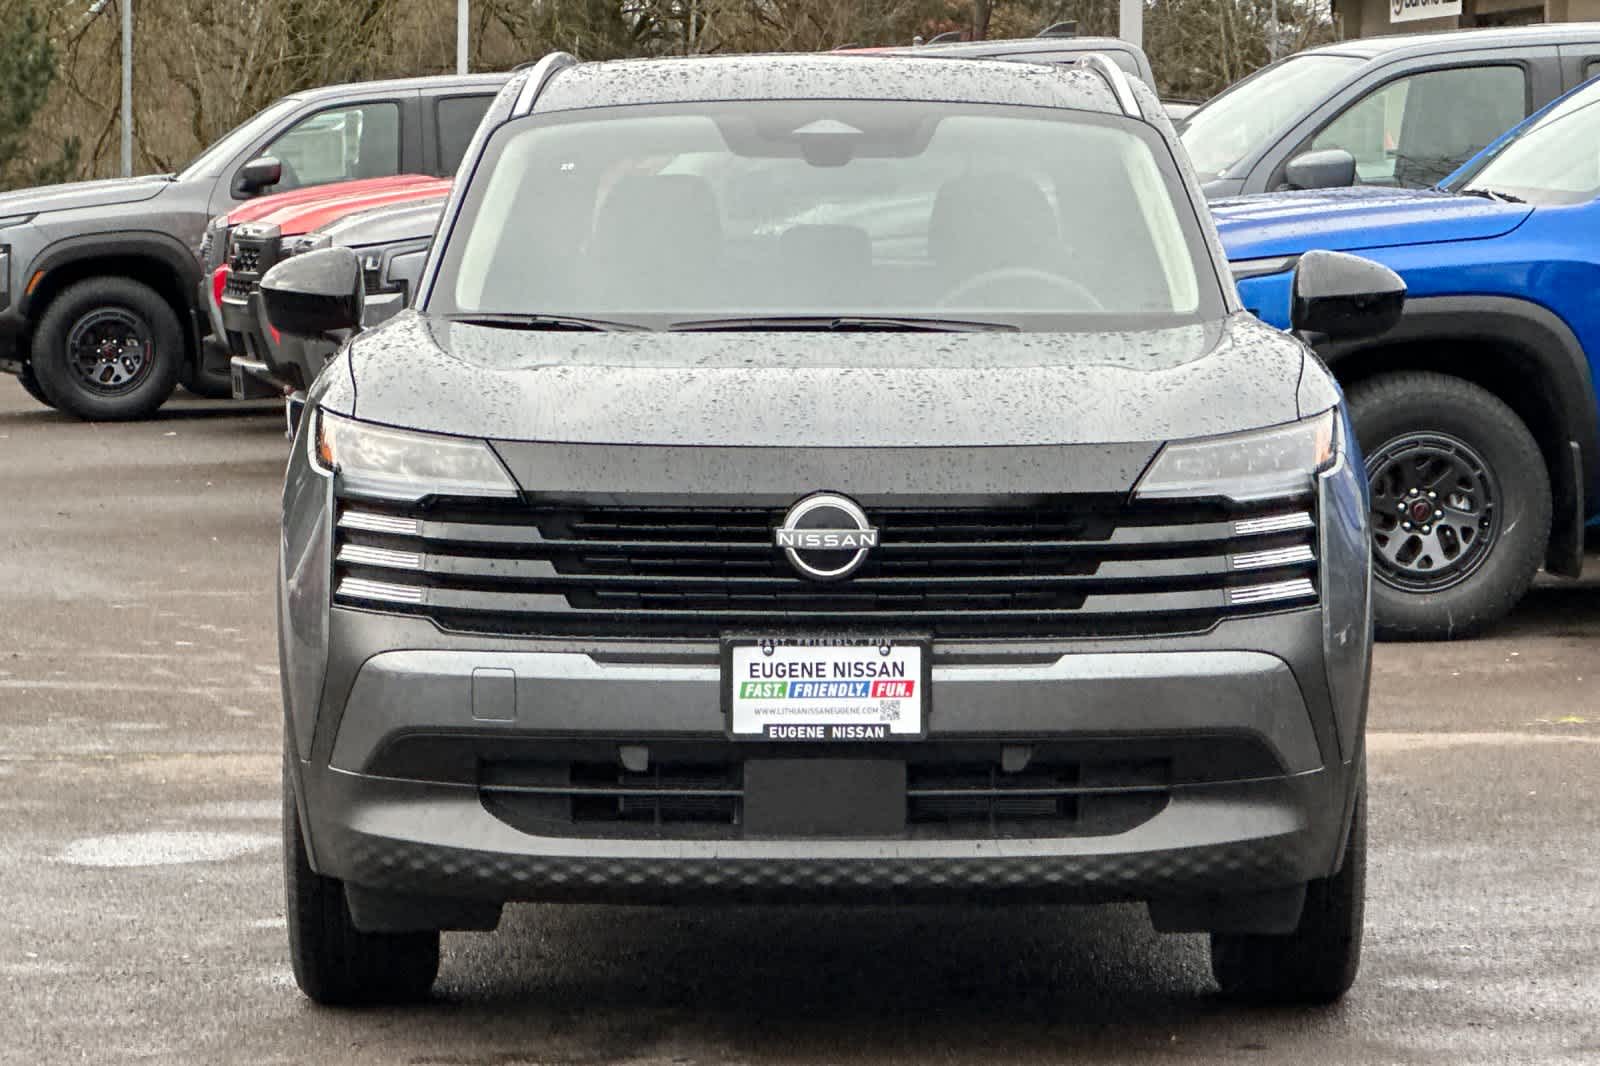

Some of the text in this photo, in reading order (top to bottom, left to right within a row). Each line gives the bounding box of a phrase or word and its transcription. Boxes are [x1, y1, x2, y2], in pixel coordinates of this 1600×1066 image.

[779, 533, 875, 547] NISSAN
[749, 661, 905, 679] EUGENE NISSAN
[745, 681, 911, 697] FAST. FRIENDLY. FUN.
[769, 726, 885, 738] EUGENE NISSAN
